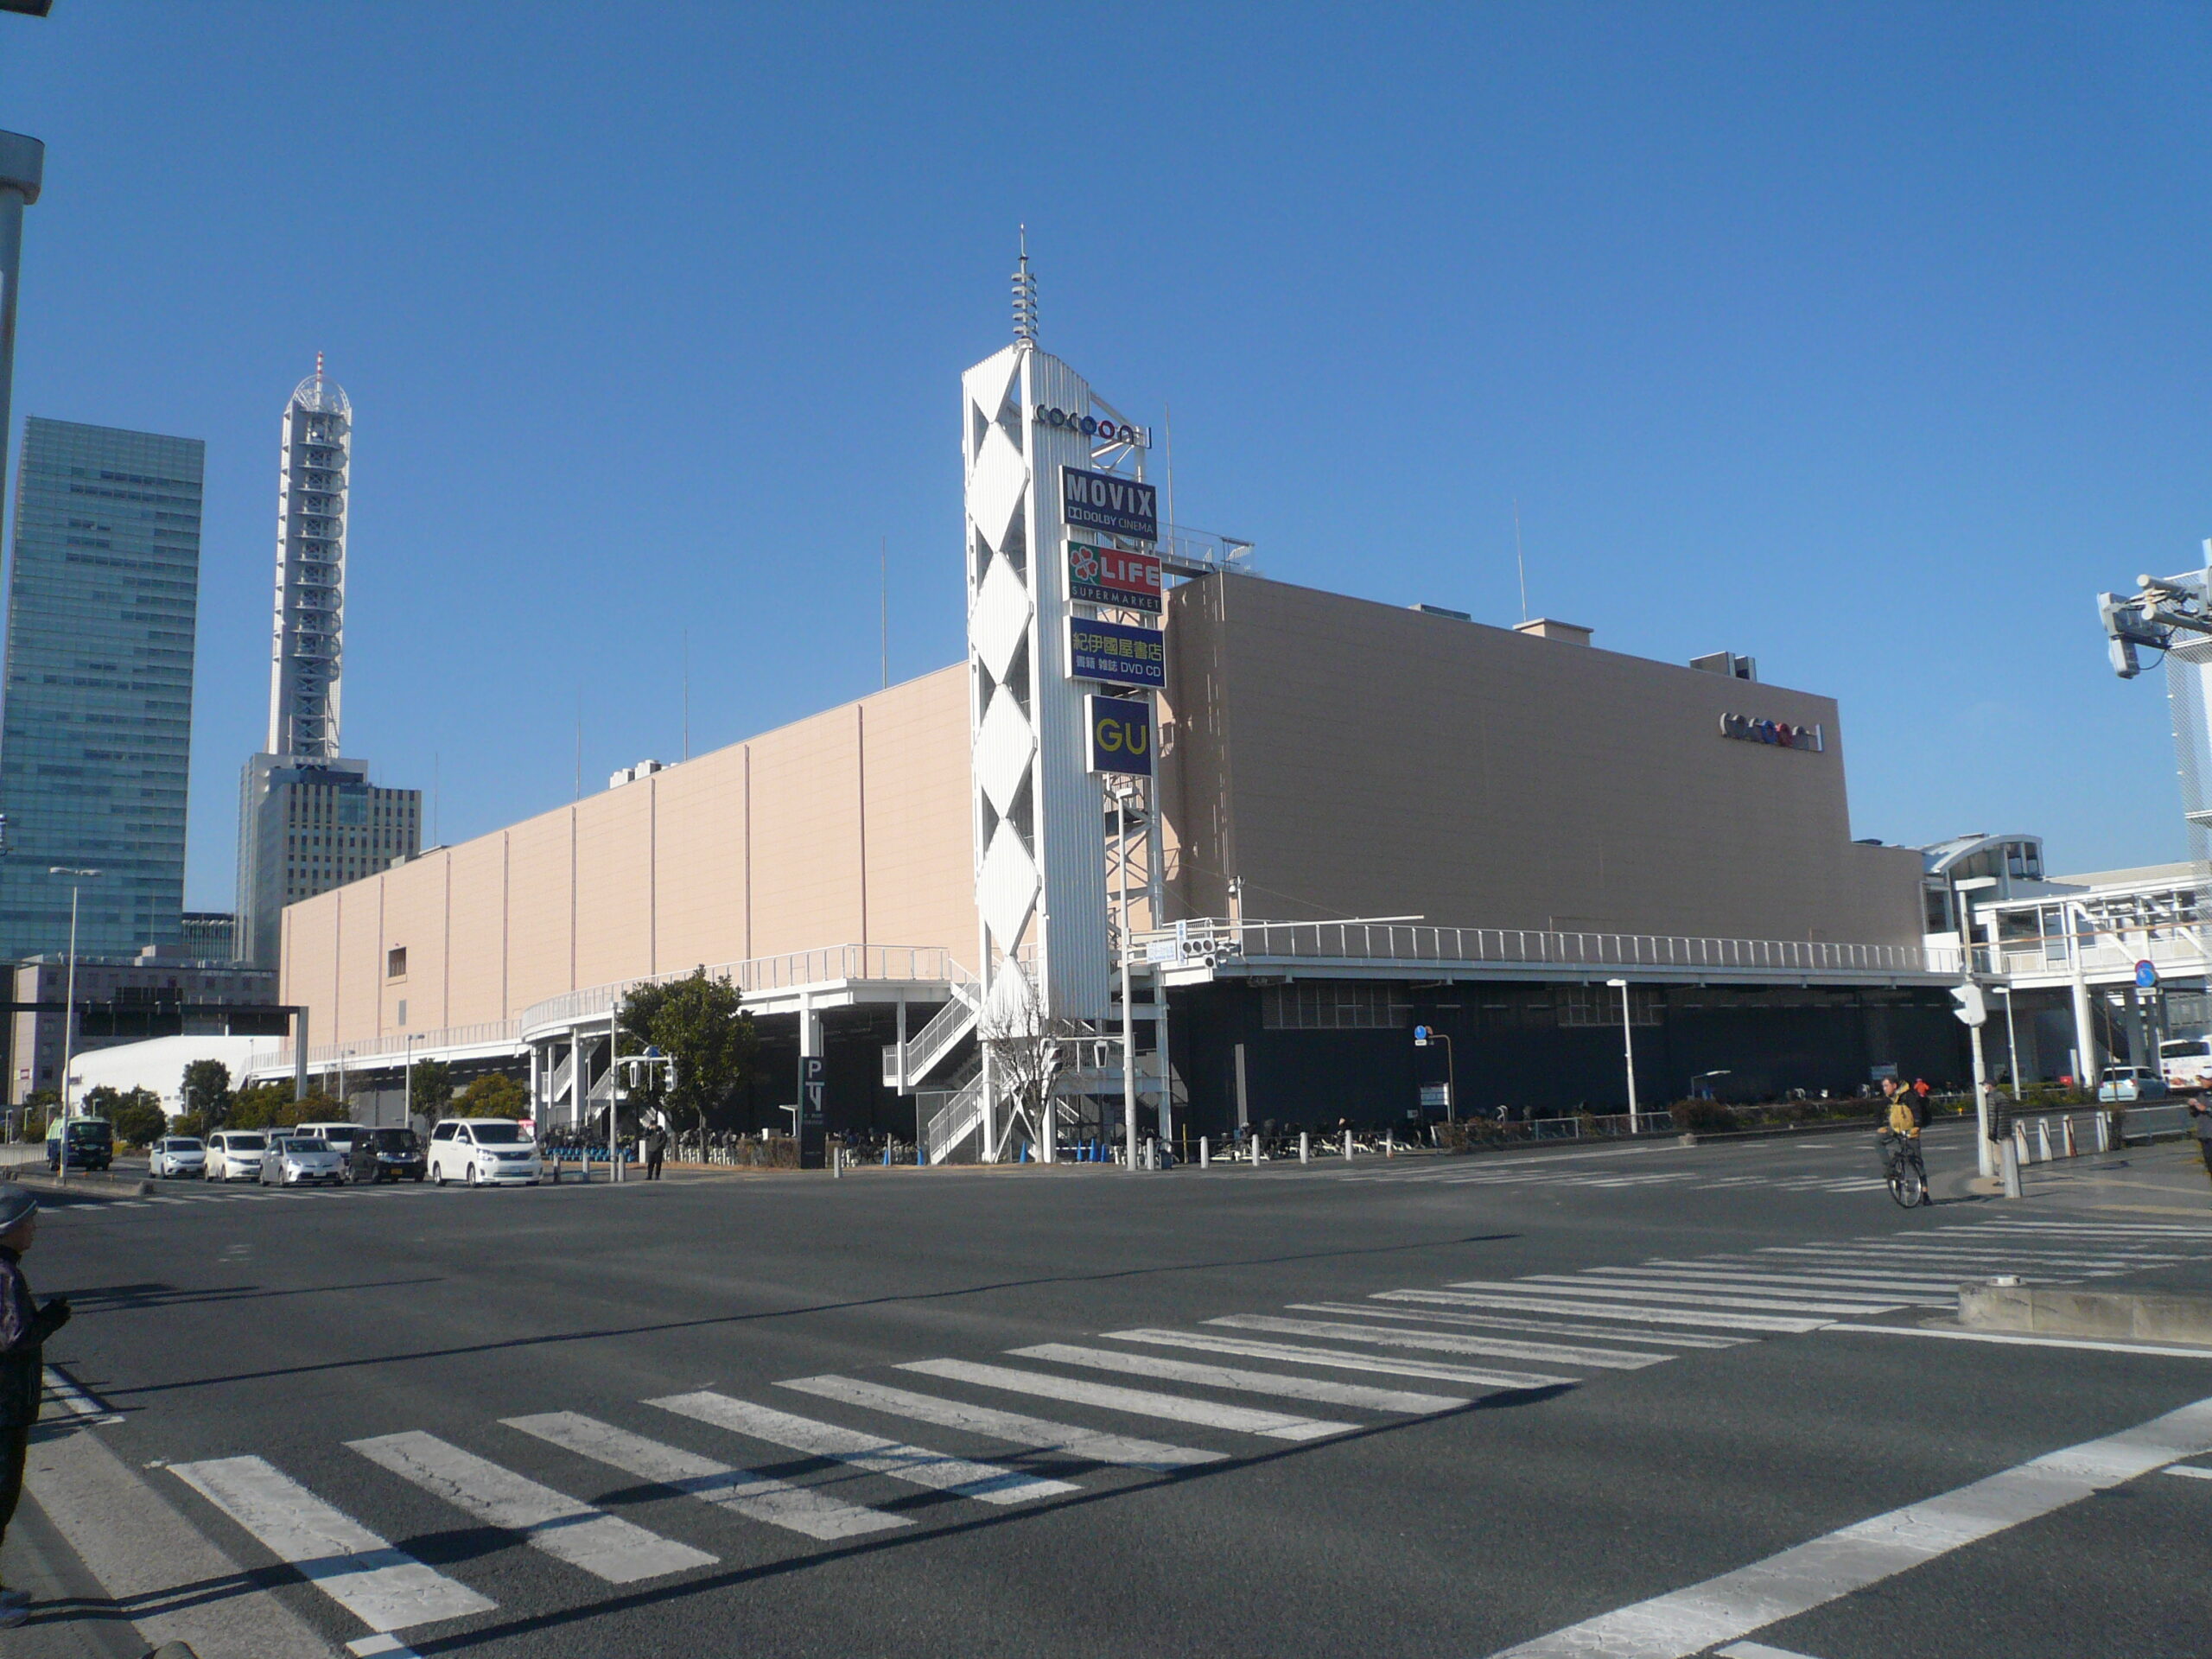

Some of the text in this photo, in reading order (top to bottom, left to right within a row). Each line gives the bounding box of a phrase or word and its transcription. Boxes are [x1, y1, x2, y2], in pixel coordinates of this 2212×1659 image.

[1067, 474, 1153, 518] MOVIX
[1084, 512, 1154, 533] DOLBY CINEMA
[1101, 556, 1160, 587] LIFE
[1072, 586, 1159, 609] SUPERMARKET
[1072, 632, 1162, 661] 紀伊國屋書店
[1121, 662, 1143, 675] DVD
[1146, 665, 1161, 677] CD
[1096, 718, 1147, 754] GU
[808, 1059, 822, 1078] P
